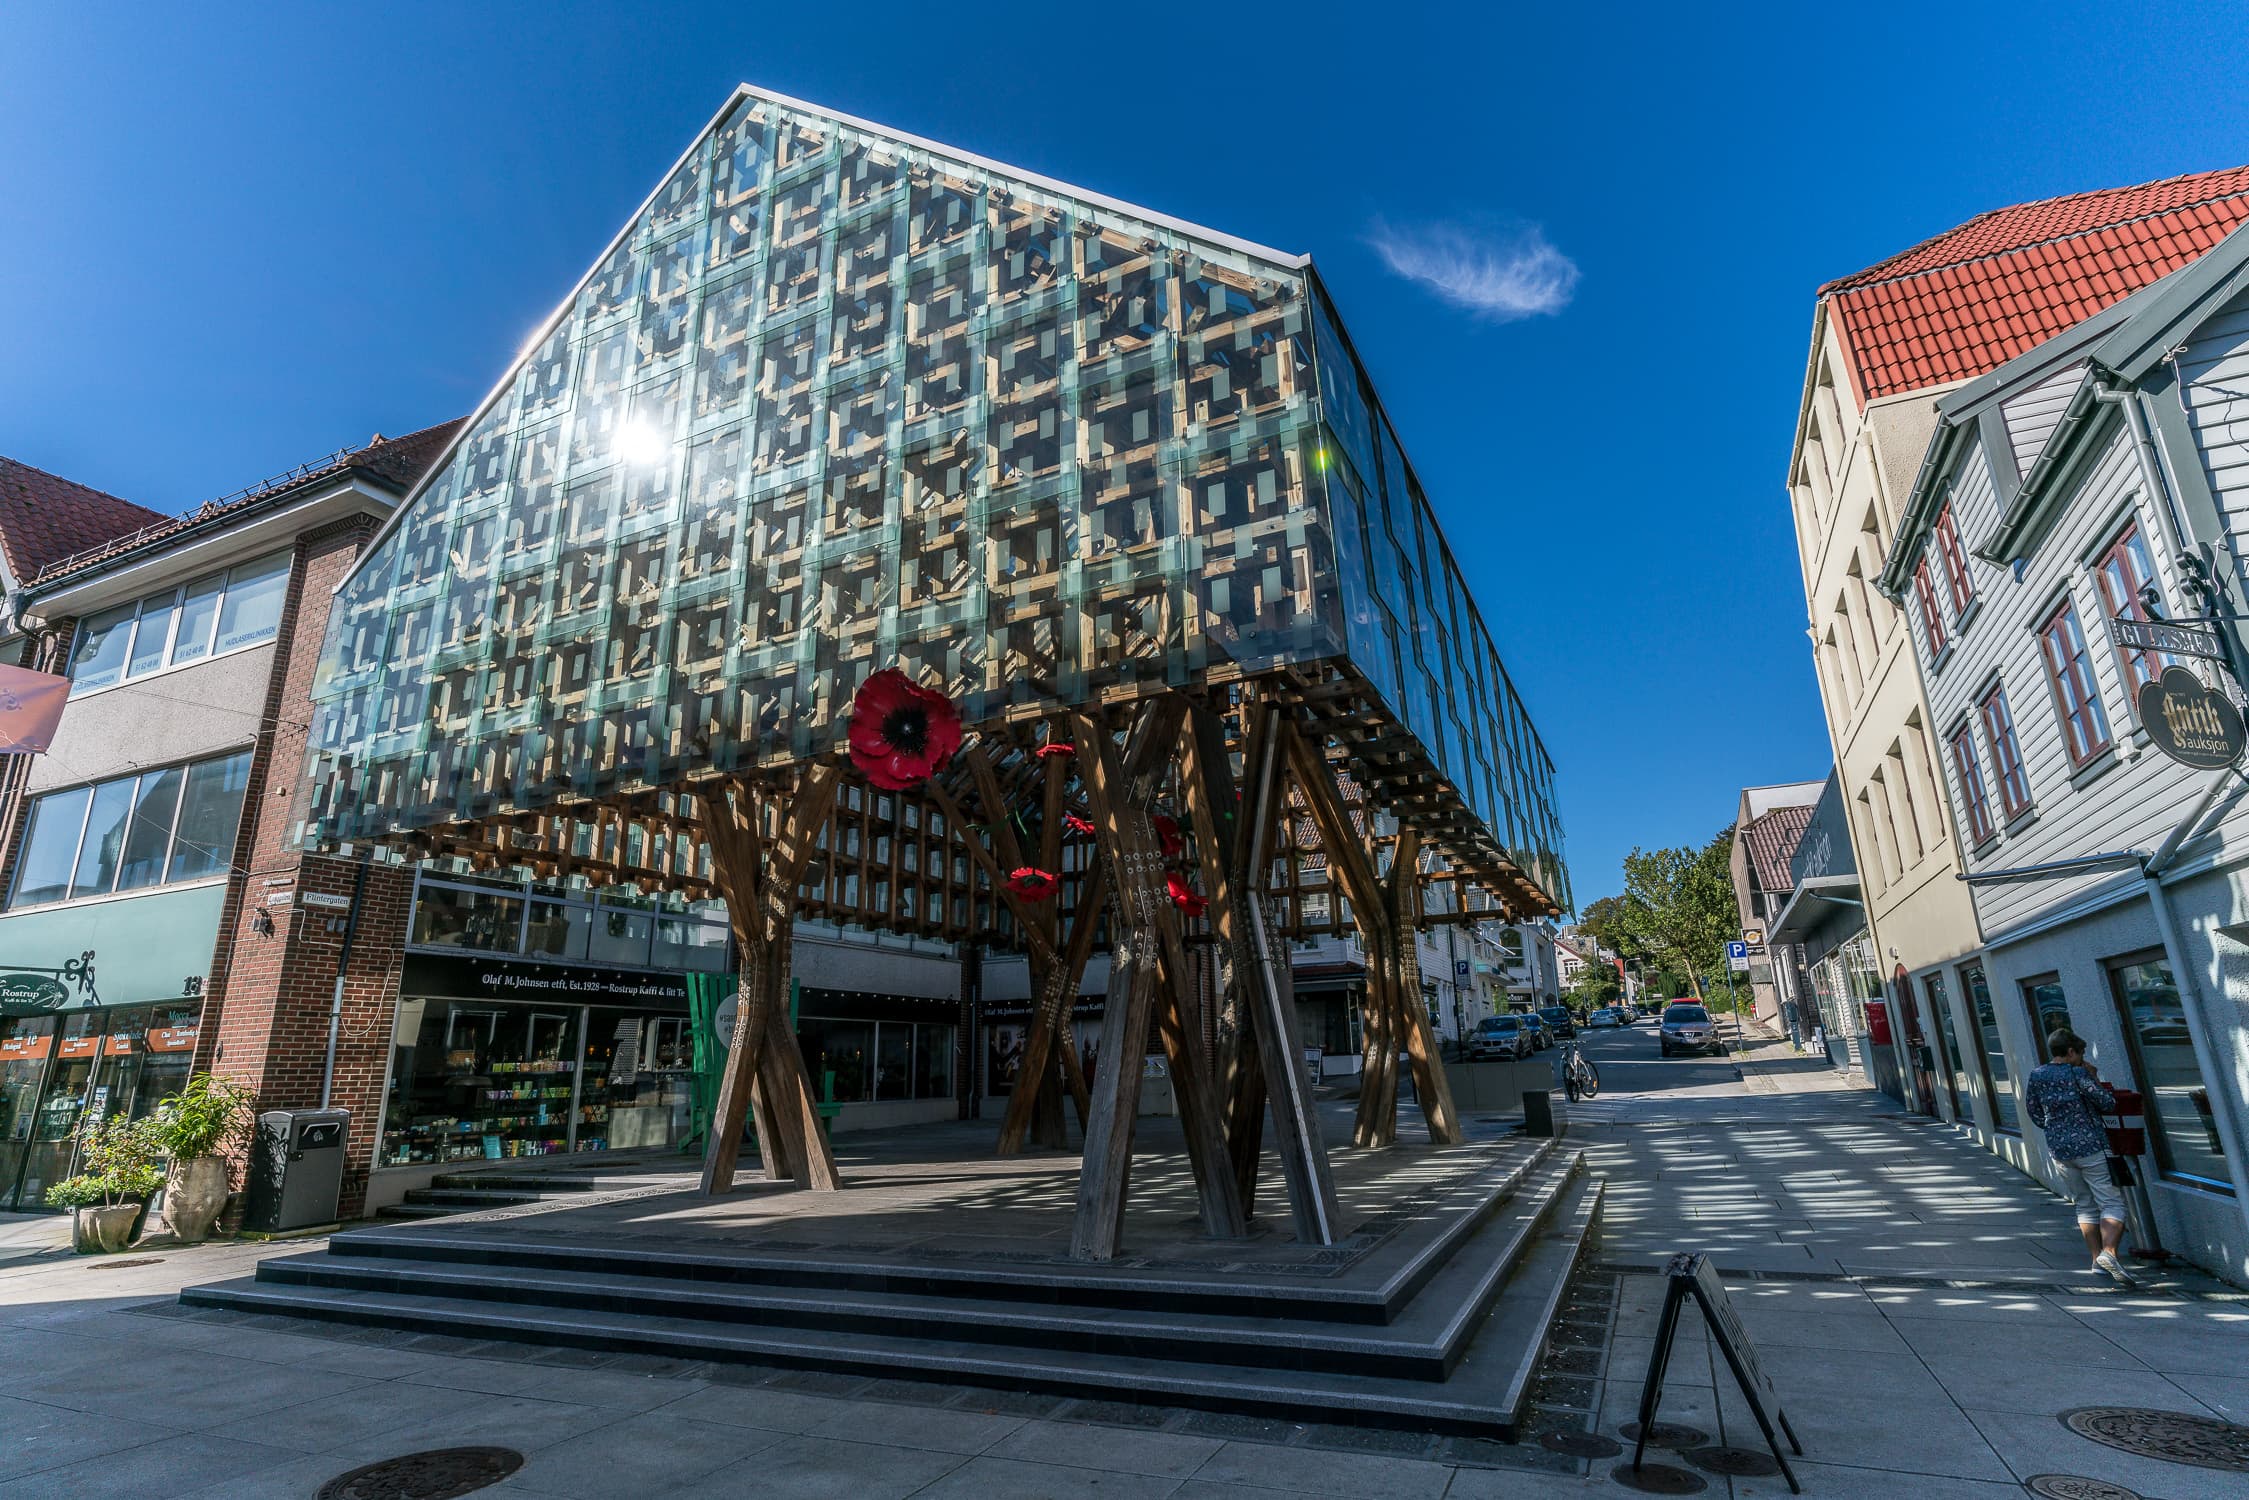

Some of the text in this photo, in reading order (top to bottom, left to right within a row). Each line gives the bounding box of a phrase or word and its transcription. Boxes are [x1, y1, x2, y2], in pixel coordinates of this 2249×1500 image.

[2162, 692, 2224, 737] Antik
[2187, 736, 2229, 754] auksjon
[306, 893, 348, 905] Flintergaten
[1733, 944, 1743, 957] P
[482, 974, 503, 985] Olaf
[608, 983, 638, 996] Rostrup
[639, 985, 657, 996] Kaffi
[658, 986, 665, 996] &
[676, 988, 685, 997] Te
[1, 989, 40, 1000] Rostrup
